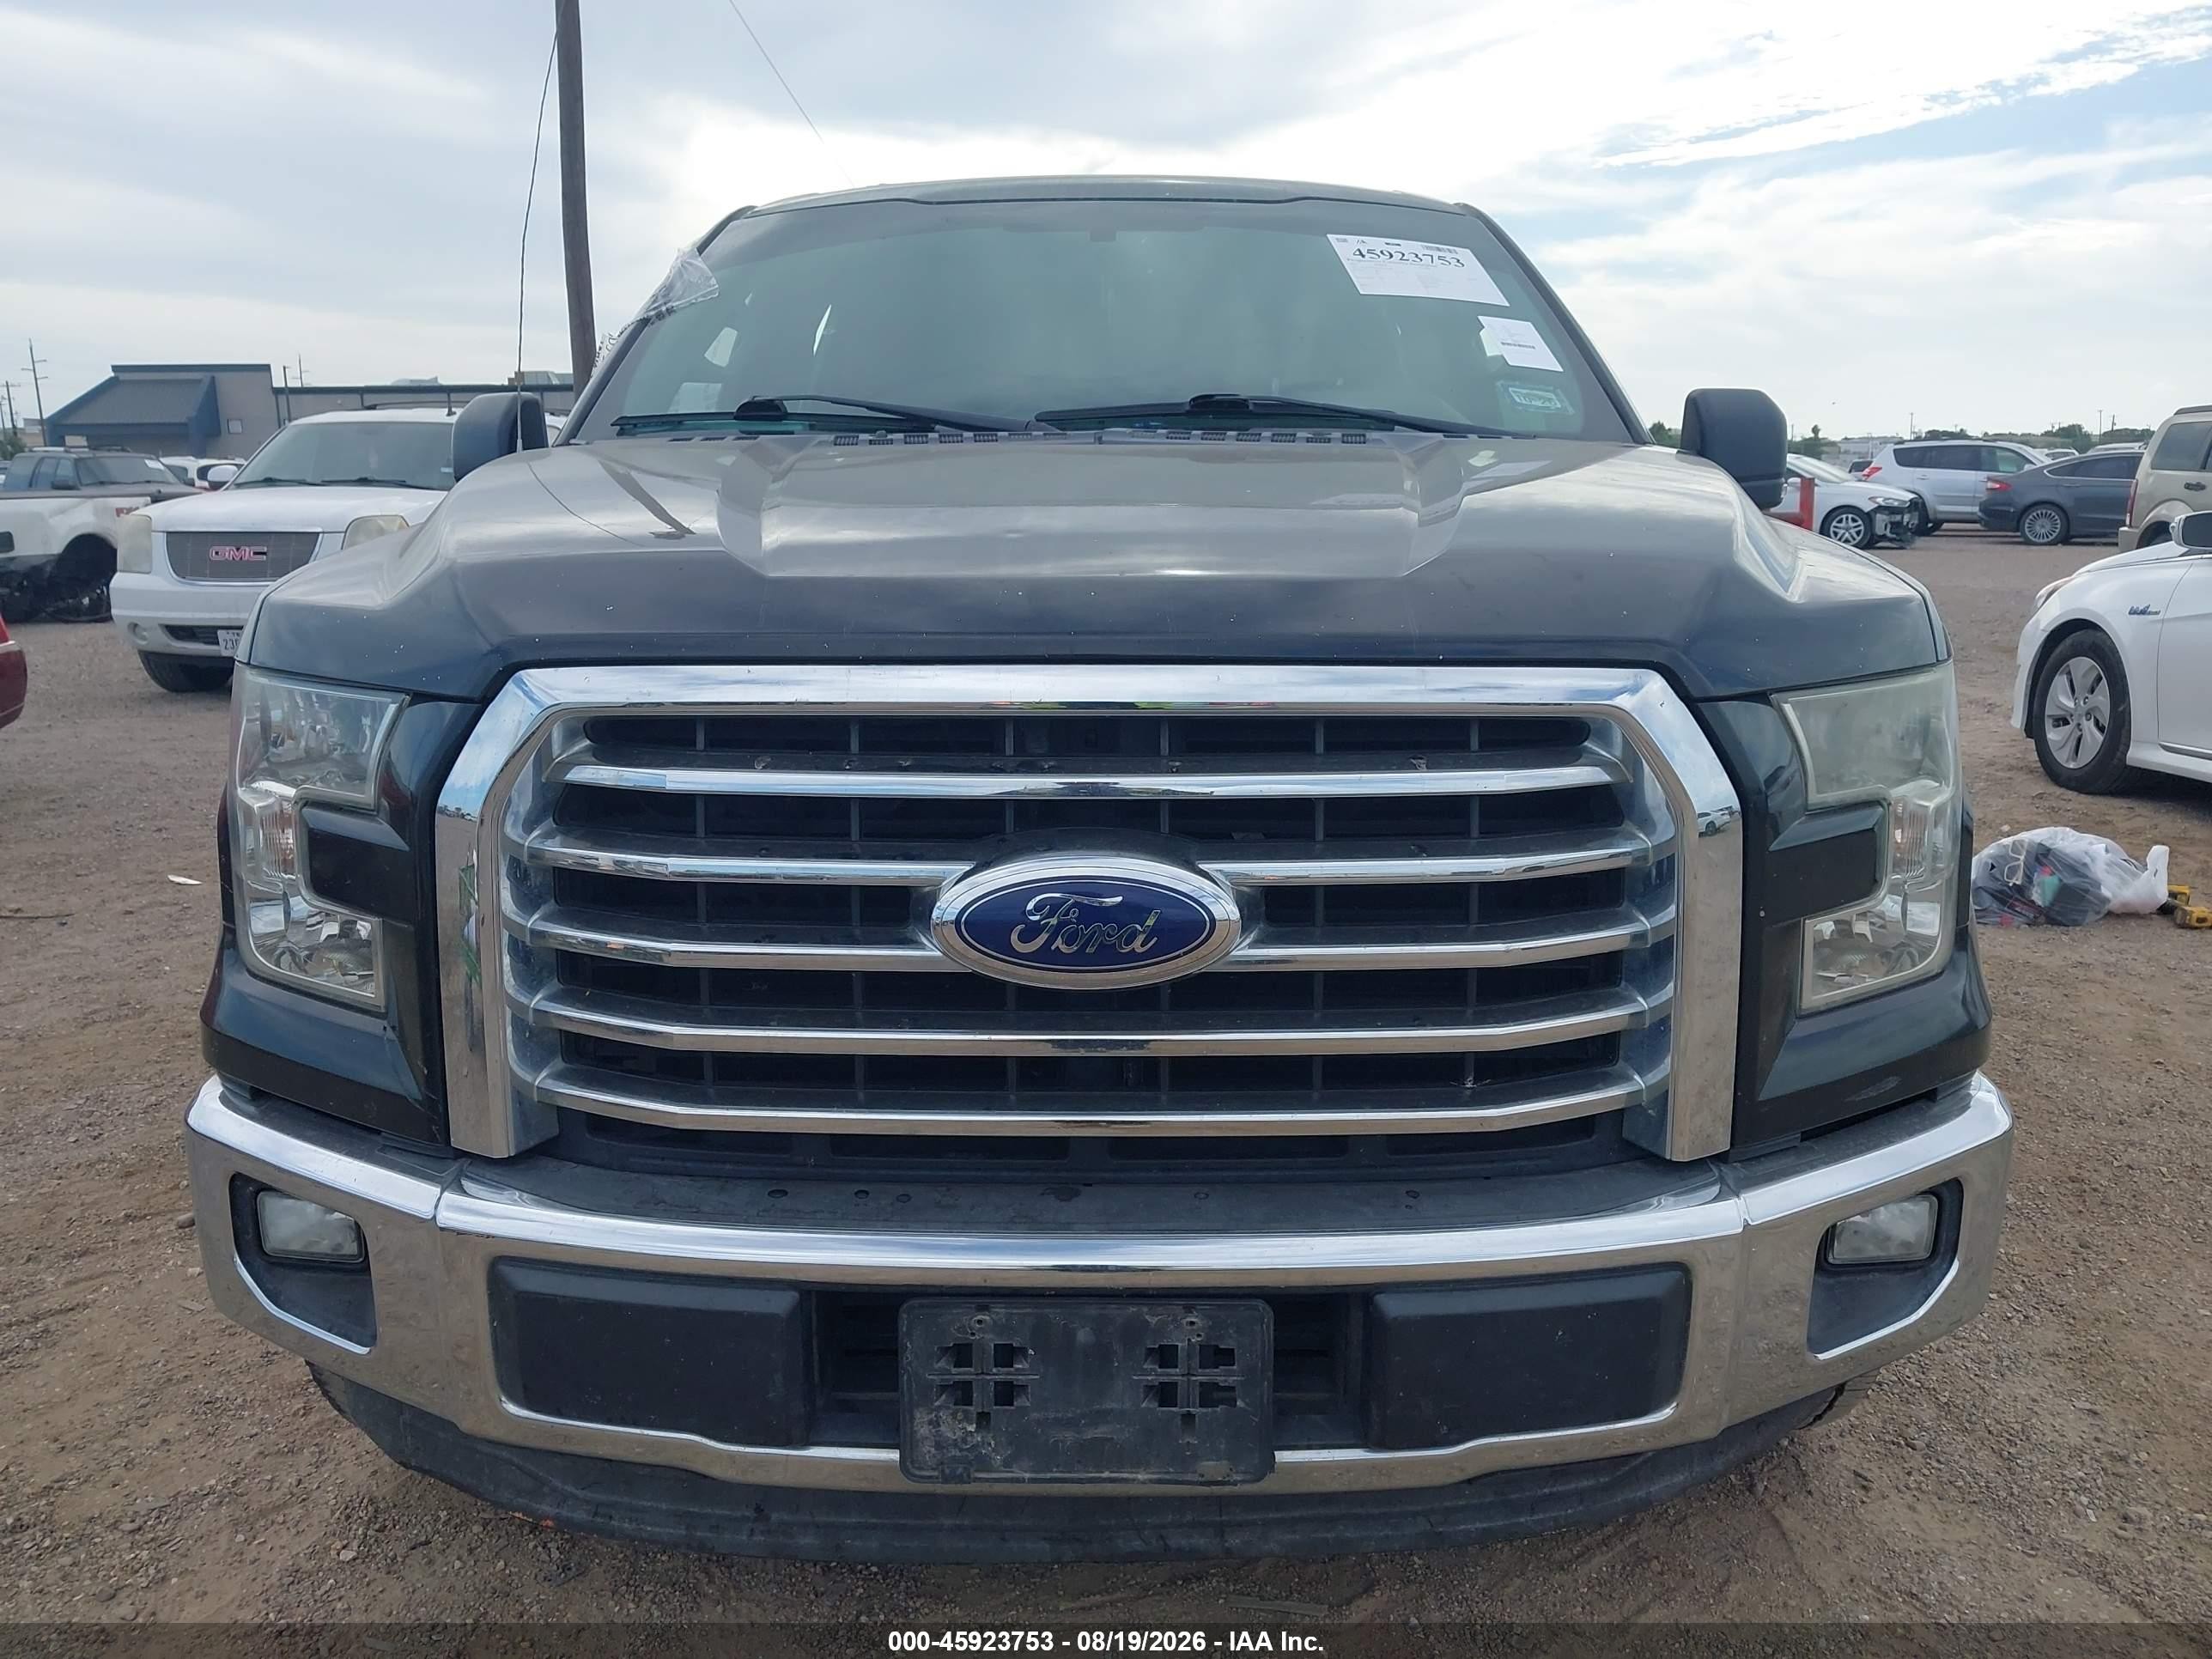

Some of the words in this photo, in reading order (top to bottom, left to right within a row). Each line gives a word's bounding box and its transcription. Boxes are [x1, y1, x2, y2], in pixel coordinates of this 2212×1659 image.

[1352, 247, 1466, 268] 45923753
[210, 545, 267, 561] GMC
[1010, 892, 1161, 954] Ford
